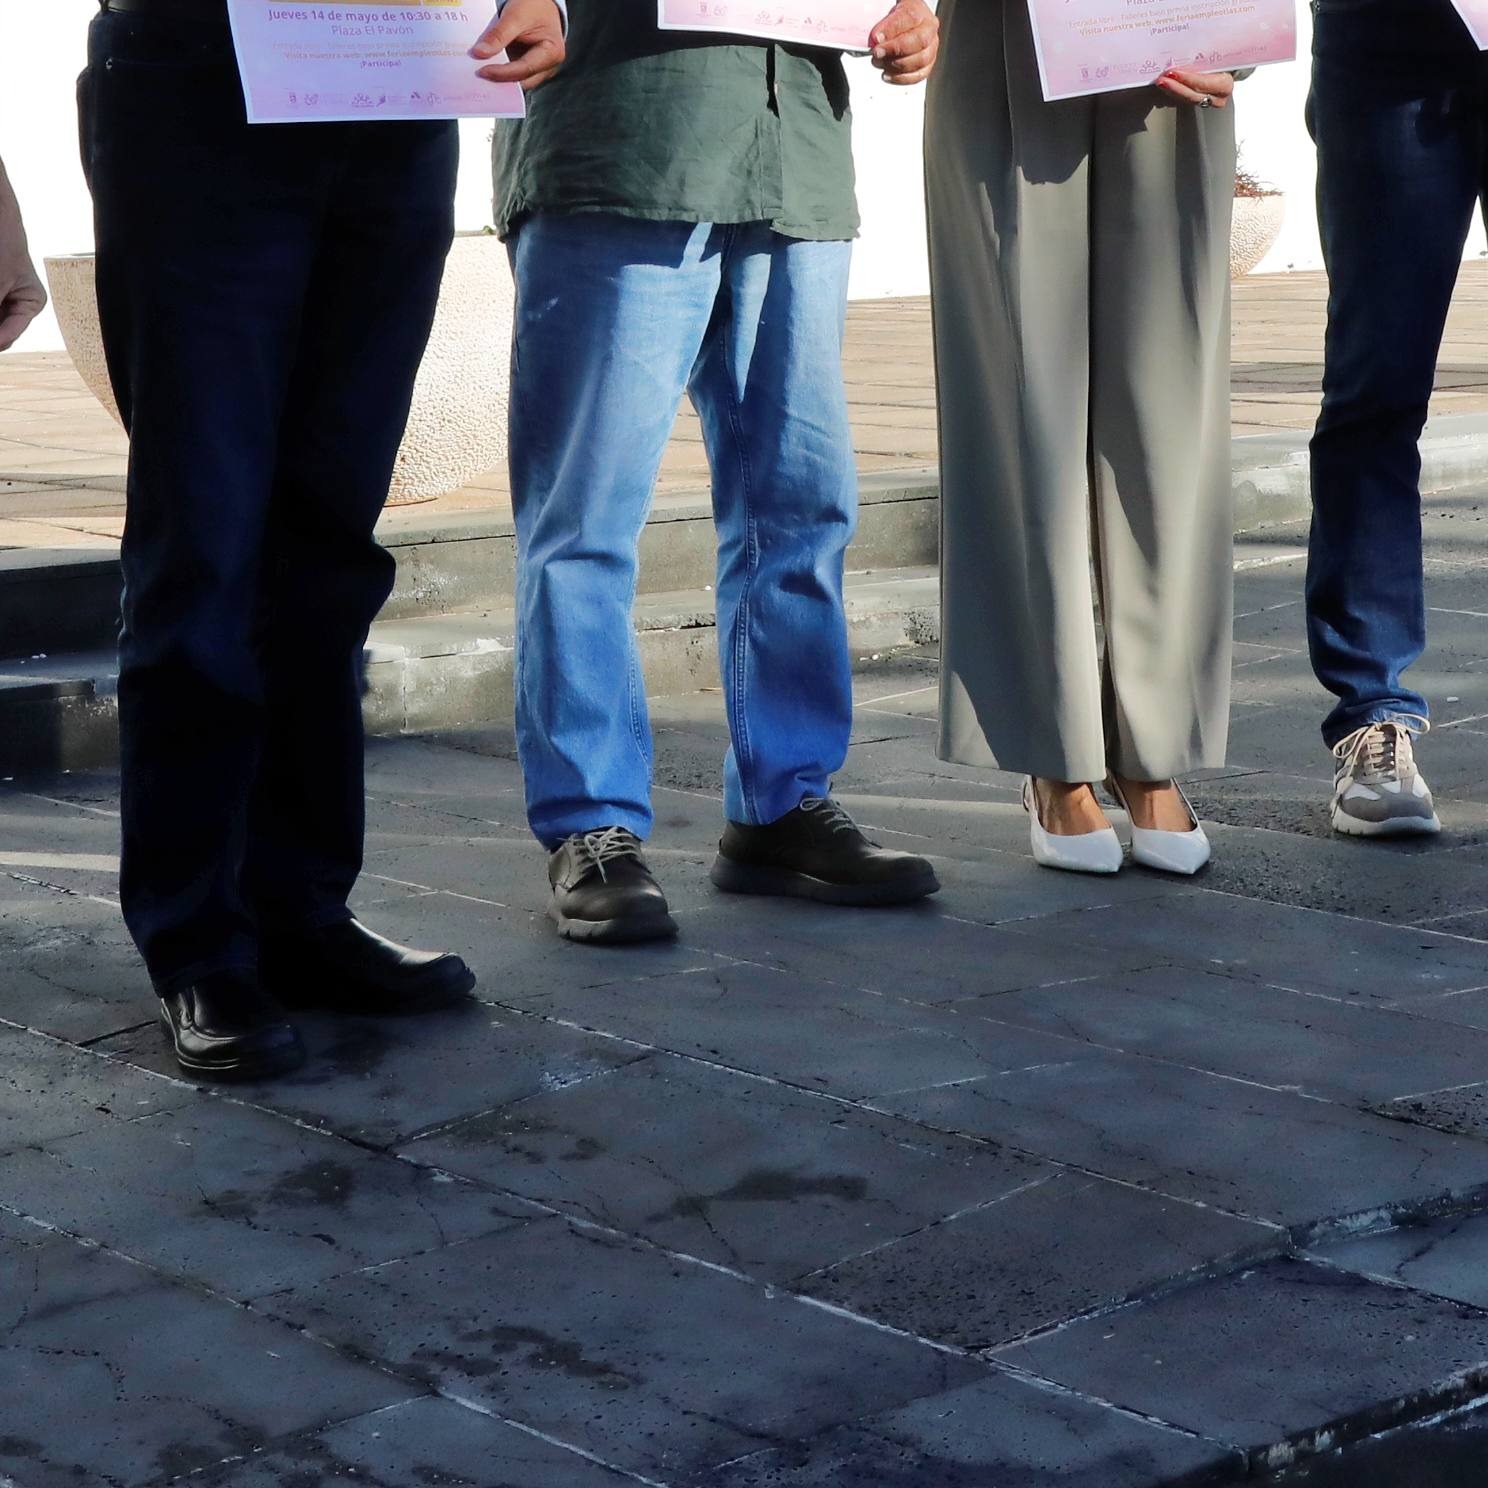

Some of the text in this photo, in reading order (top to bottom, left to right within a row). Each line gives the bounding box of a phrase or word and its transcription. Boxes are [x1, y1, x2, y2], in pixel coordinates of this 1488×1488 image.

[268, 10, 468, 24] Jueves 14 de mayo de 10:30 a 18 h
